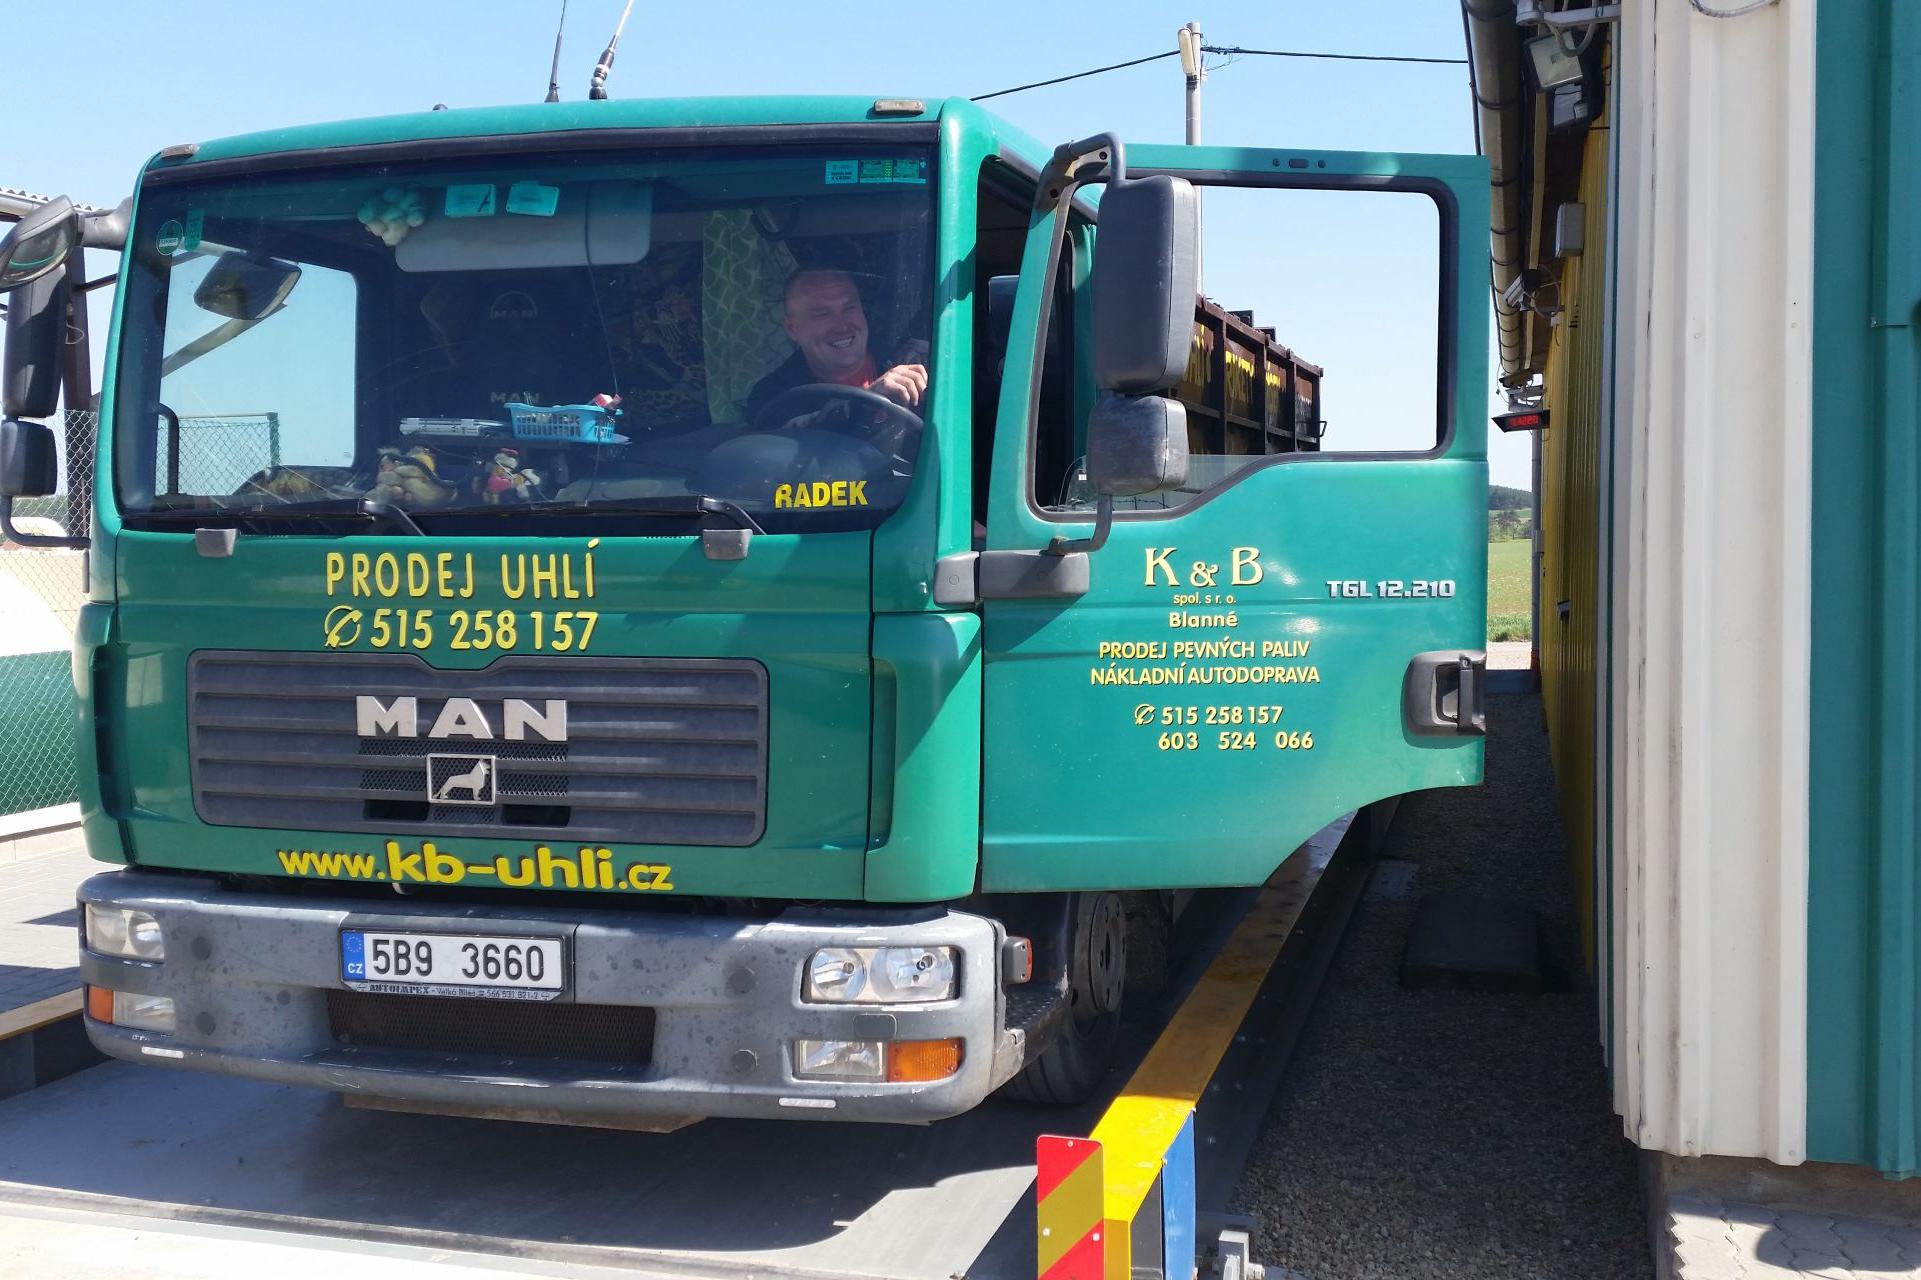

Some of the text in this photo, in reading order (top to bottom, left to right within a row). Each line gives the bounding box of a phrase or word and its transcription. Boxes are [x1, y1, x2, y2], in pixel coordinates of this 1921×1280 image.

[774, 480, 869, 509] RADEK
[326, 537, 600, 599] PRODEJ UHLÍ
[1144, 546, 1264, 587] K & B
[1173, 592, 1237, 606] spol. s r. o.
[1326, 579, 1457, 598] TGL 12.210
[370, 608, 599, 652] 515 258 157
[1169, 611, 1239, 629] Blanné
[1099, 636, 1311, 660] PRODEJ PEVNÝCH PALIV
[1090, 661, 1321, 686] NÁKLADNÍ AUTODOPRAVA
[356, 695, 568, 742] MAN
[1161, 706, 1284, 725] 515 258 157
[1158, 731, 1314, 751] 603 524 066
[278, 841, 674, 892] www.kb-uhli.cz
[347, 962, 363, 975] CZ
[372, 938, 545, 982] 5B9 3660
